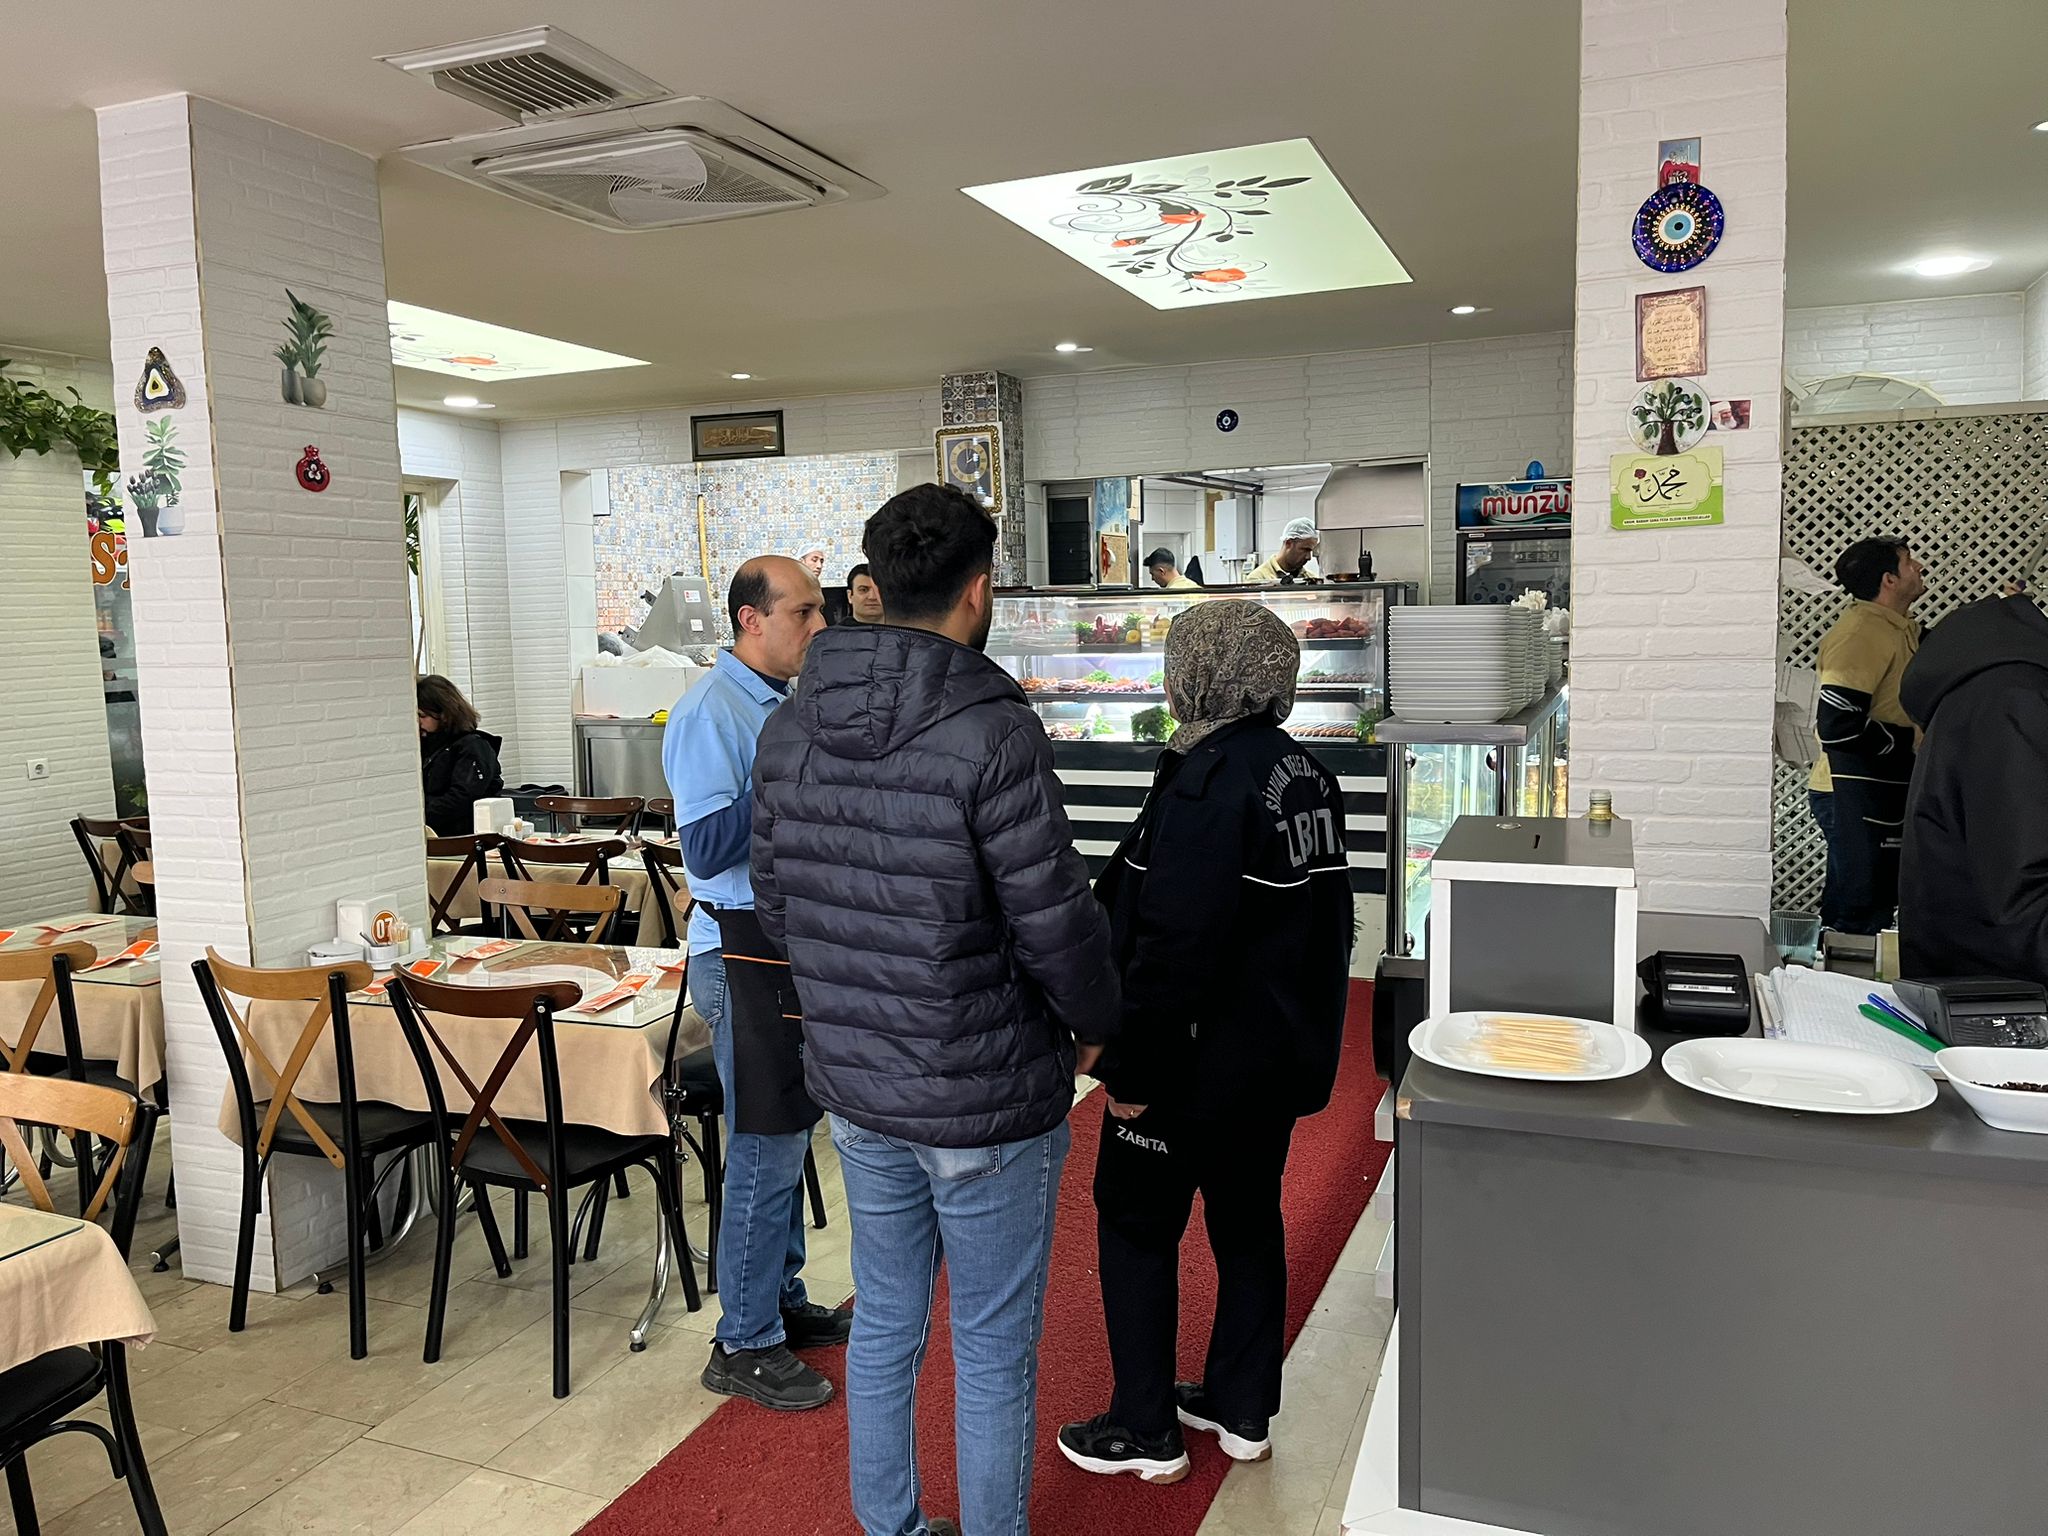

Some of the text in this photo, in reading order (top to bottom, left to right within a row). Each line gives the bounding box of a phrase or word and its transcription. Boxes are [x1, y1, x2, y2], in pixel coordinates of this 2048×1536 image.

[1481, 494, 1571, 517] munzu
[376, 917, 394, 940] 07
[1116, 1125, 1169, 1154] ZABITA
